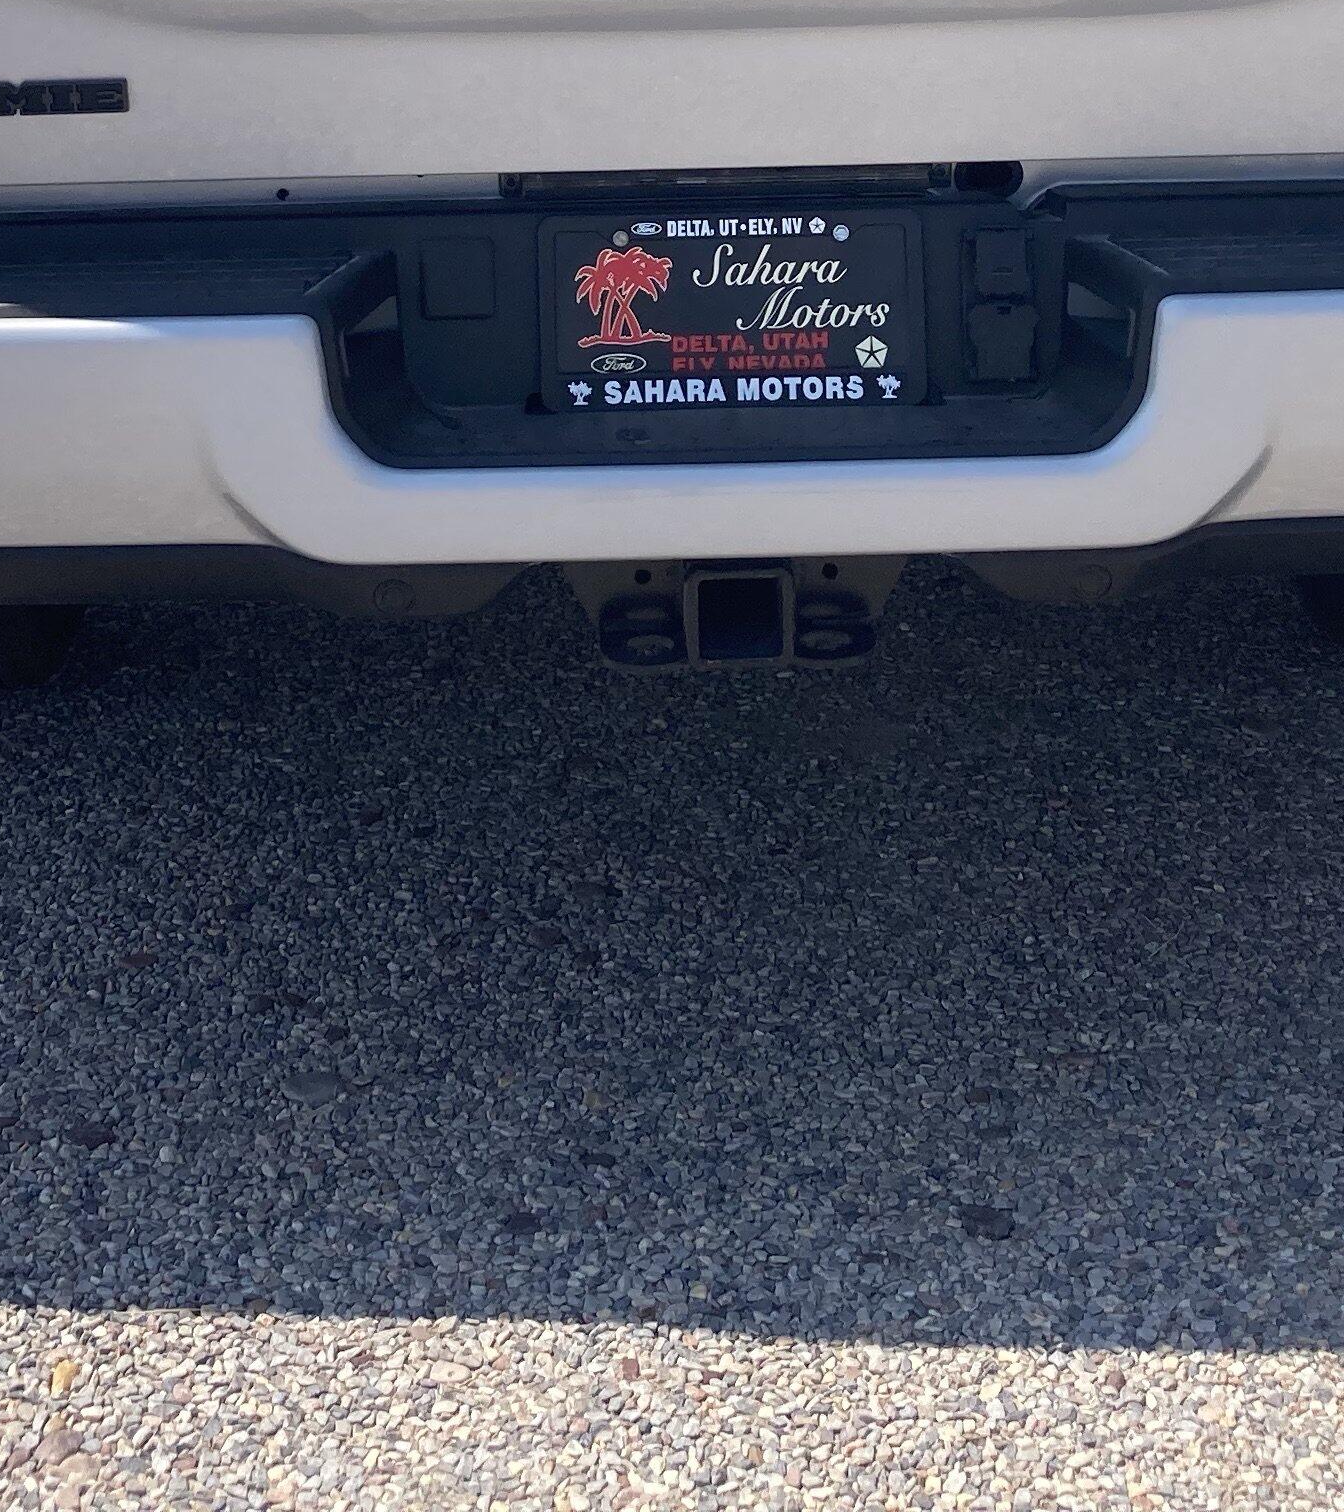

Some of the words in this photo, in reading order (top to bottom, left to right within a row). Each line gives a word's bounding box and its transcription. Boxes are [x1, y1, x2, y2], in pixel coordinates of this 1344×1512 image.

[666, 219, 715, 237] DELTA,
[781, 217, 803, 235] NV
[691, 243, 849, 287] Sahara
[735, 285, 891, 331] Motors
[672, 333, 755, 354] DELTA,
[762, 331, 830, 352] UTAH
[600, 355, 637, 373] Ford
[727, 353, 828, 370] NEVADA
[604, 377, 727, 405] SAHARA
[736, 375, 865, 402] MOTORS
